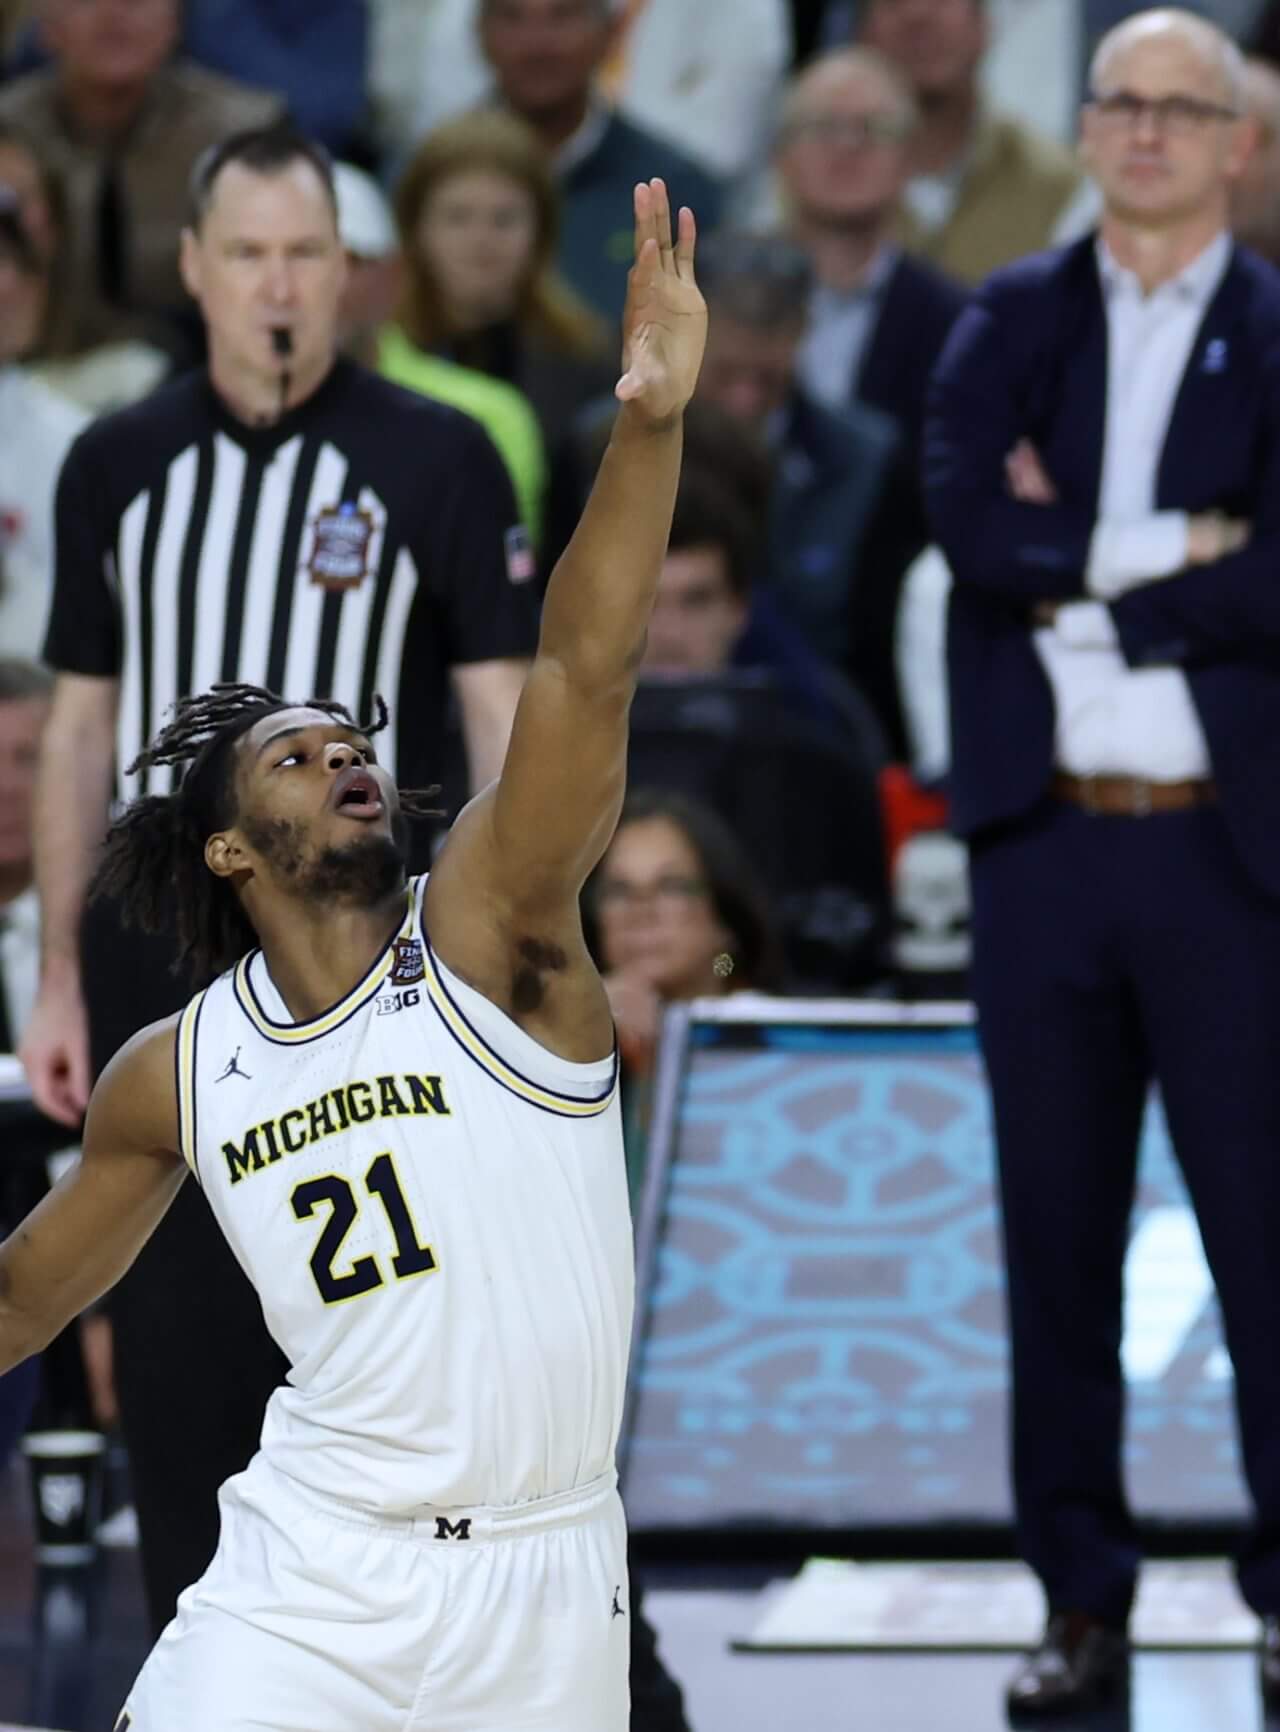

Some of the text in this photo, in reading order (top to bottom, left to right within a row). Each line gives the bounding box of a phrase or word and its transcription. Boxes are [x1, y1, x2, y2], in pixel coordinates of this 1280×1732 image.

[399, 946, 422, 957] FIN
[220, 1073, 452, 1187] MICHIGAN
[289, 1150, 440, 1307] 21
[433, 1516, 472, 1540] M
